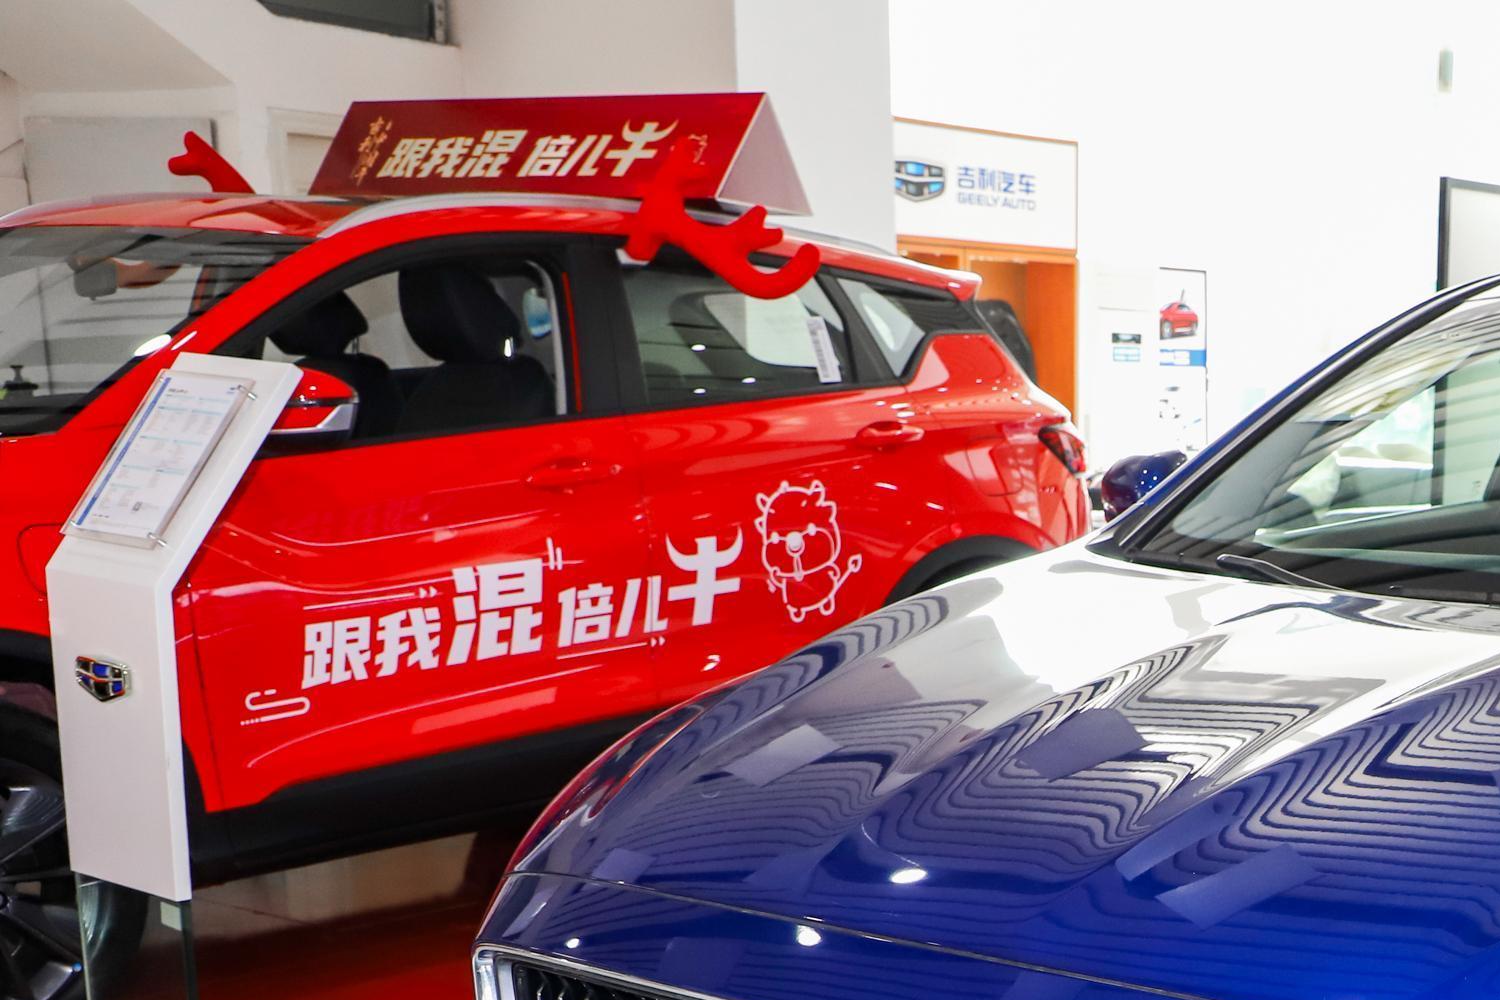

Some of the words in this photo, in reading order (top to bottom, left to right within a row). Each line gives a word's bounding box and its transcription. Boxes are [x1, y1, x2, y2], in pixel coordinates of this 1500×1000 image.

[957, 165, 1036, 195] 吉利汽车
[957, 191, 999, 207] GEELY
[1001, 197, 1037, 211] AUTO
[302, 528, 743, 690] 跟我混倍儿牛
